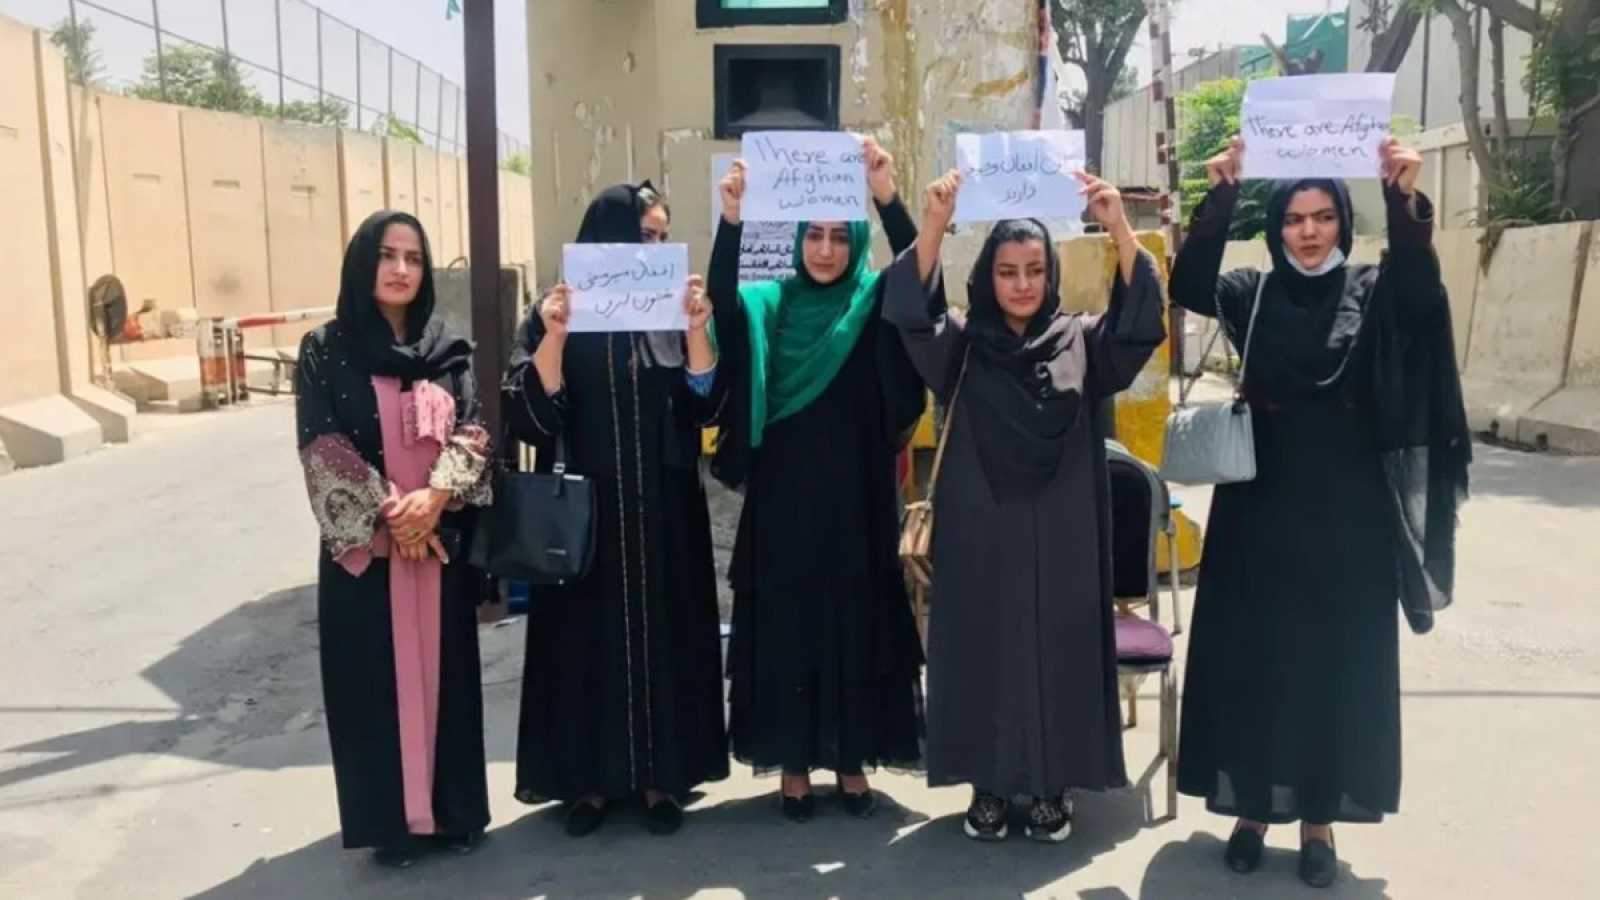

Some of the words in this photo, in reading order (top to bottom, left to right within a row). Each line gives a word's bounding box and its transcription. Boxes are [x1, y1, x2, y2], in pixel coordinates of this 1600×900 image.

[1249, 114, 1297, 138] There
[1304, 119, 1335, 136] are
[755, 136, 831, 166] There
[840, 152, 866, 164] are
[772, 167, 855, 194] Afghan
[779, 194, 860, 210] women
